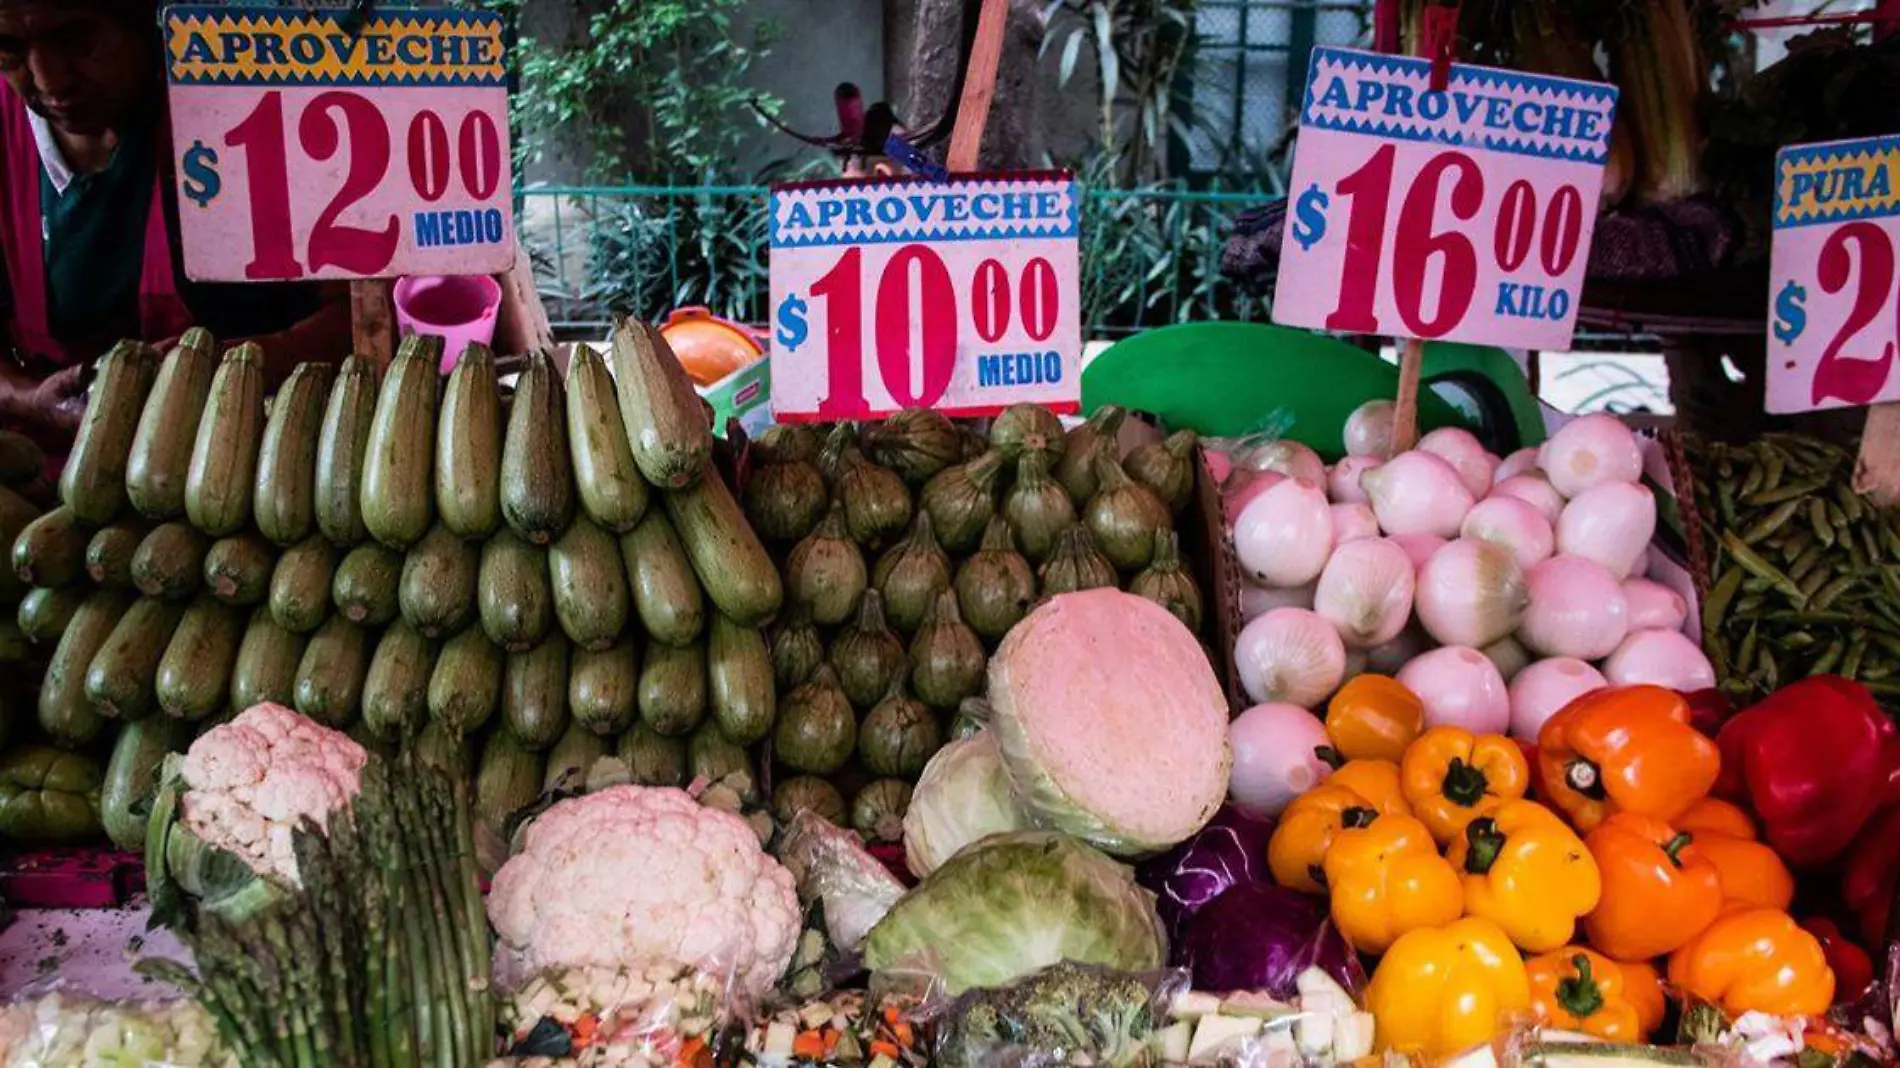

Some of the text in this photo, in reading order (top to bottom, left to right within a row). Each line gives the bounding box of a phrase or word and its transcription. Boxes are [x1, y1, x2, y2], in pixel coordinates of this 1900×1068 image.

[181, 32, 497, 66] APROVECHE
[1319, 76, 1602, 140] APROVECHE
[1789, 164, 1890, 206] PURA
[415, 208, 502, 248] MEDIO
[784, 192, 1061, 229] APROVECHE
[1495, 281, 1569, 321] KILO
[978, 351, 1062, 387] MEDIO
